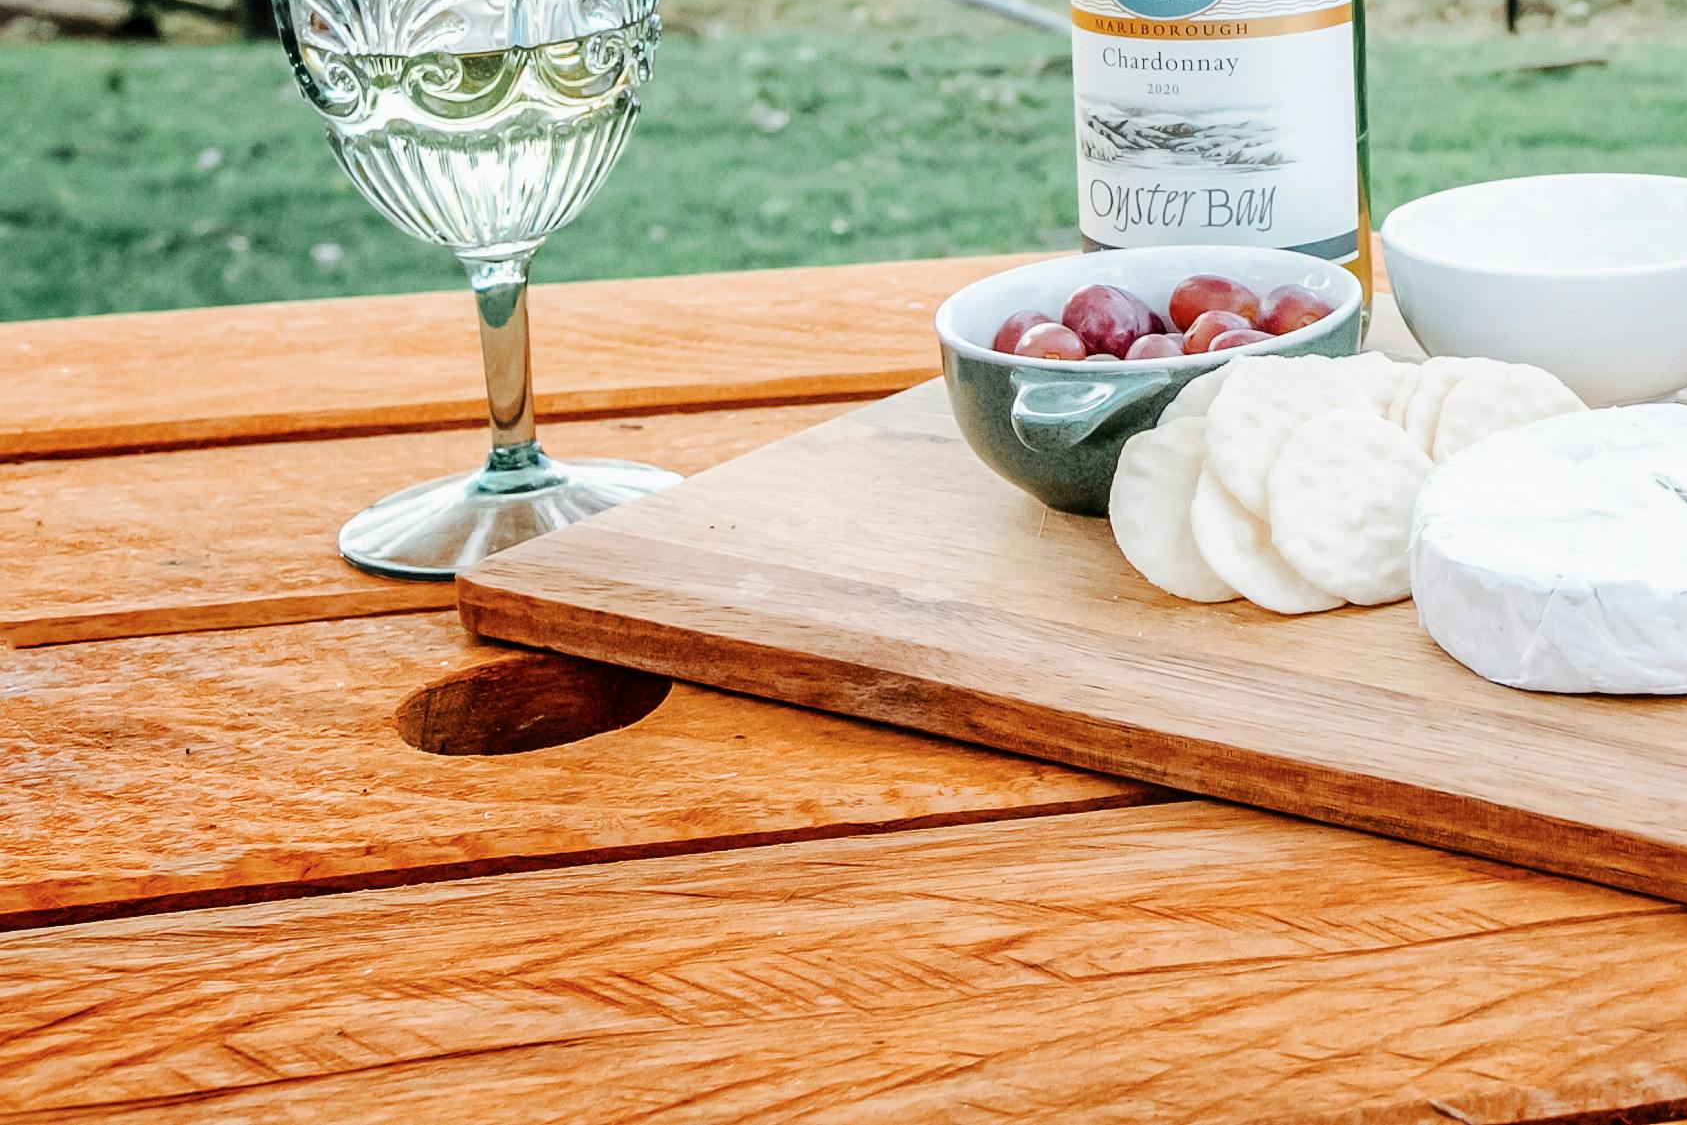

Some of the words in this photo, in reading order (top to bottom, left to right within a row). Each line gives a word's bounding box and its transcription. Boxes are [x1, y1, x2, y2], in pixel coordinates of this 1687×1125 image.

[1095, 19, 1248, 37] MARLBOROUGH
[1103, 47, 1240, 76] Chardonnay
[1147, 83, 1179, 96] 2020
[1090, 179, 1196, 232] Oyster
[1200, 185, 1276, 232] Bay
